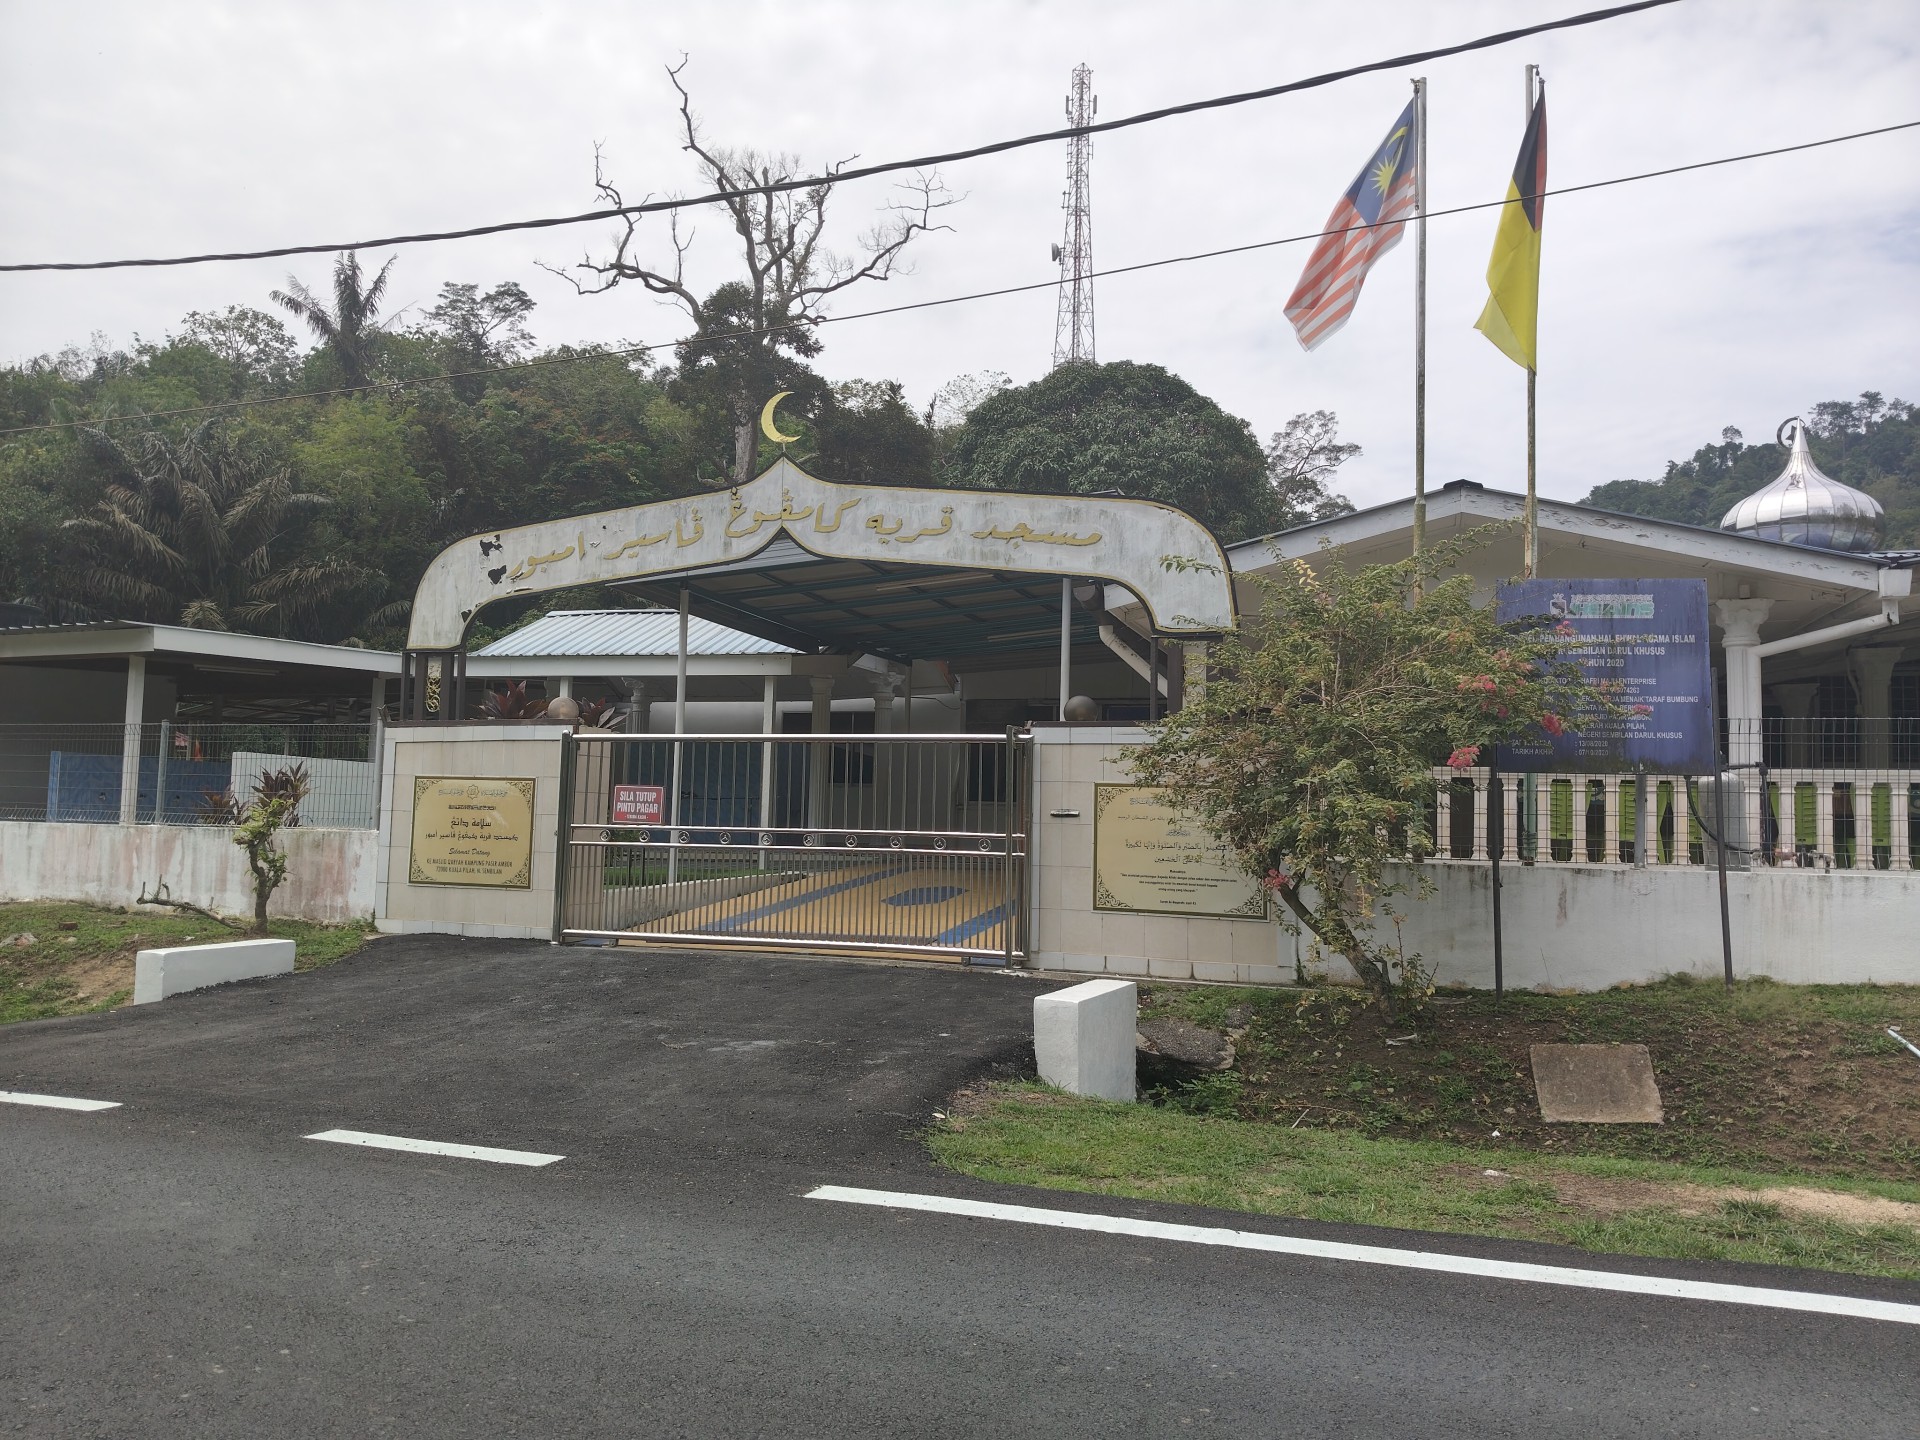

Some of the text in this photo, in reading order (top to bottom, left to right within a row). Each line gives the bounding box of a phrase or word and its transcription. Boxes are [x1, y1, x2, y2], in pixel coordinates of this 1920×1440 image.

[1598, 634, 1613, 643] HAL
[1672, 634, 1696, 643] ISLAM
[1608, 646, 1632, 655] DARUL
[1634, 646, 1665, 655] KHUSUS
[1606, 658, 1625, 667] 2020
[1656, 732, 1683, 740] KHUSUS
[620, 791, 657, 802] SILA TUTUP
[617, 802, 658, 813] PINTU PAGAR
